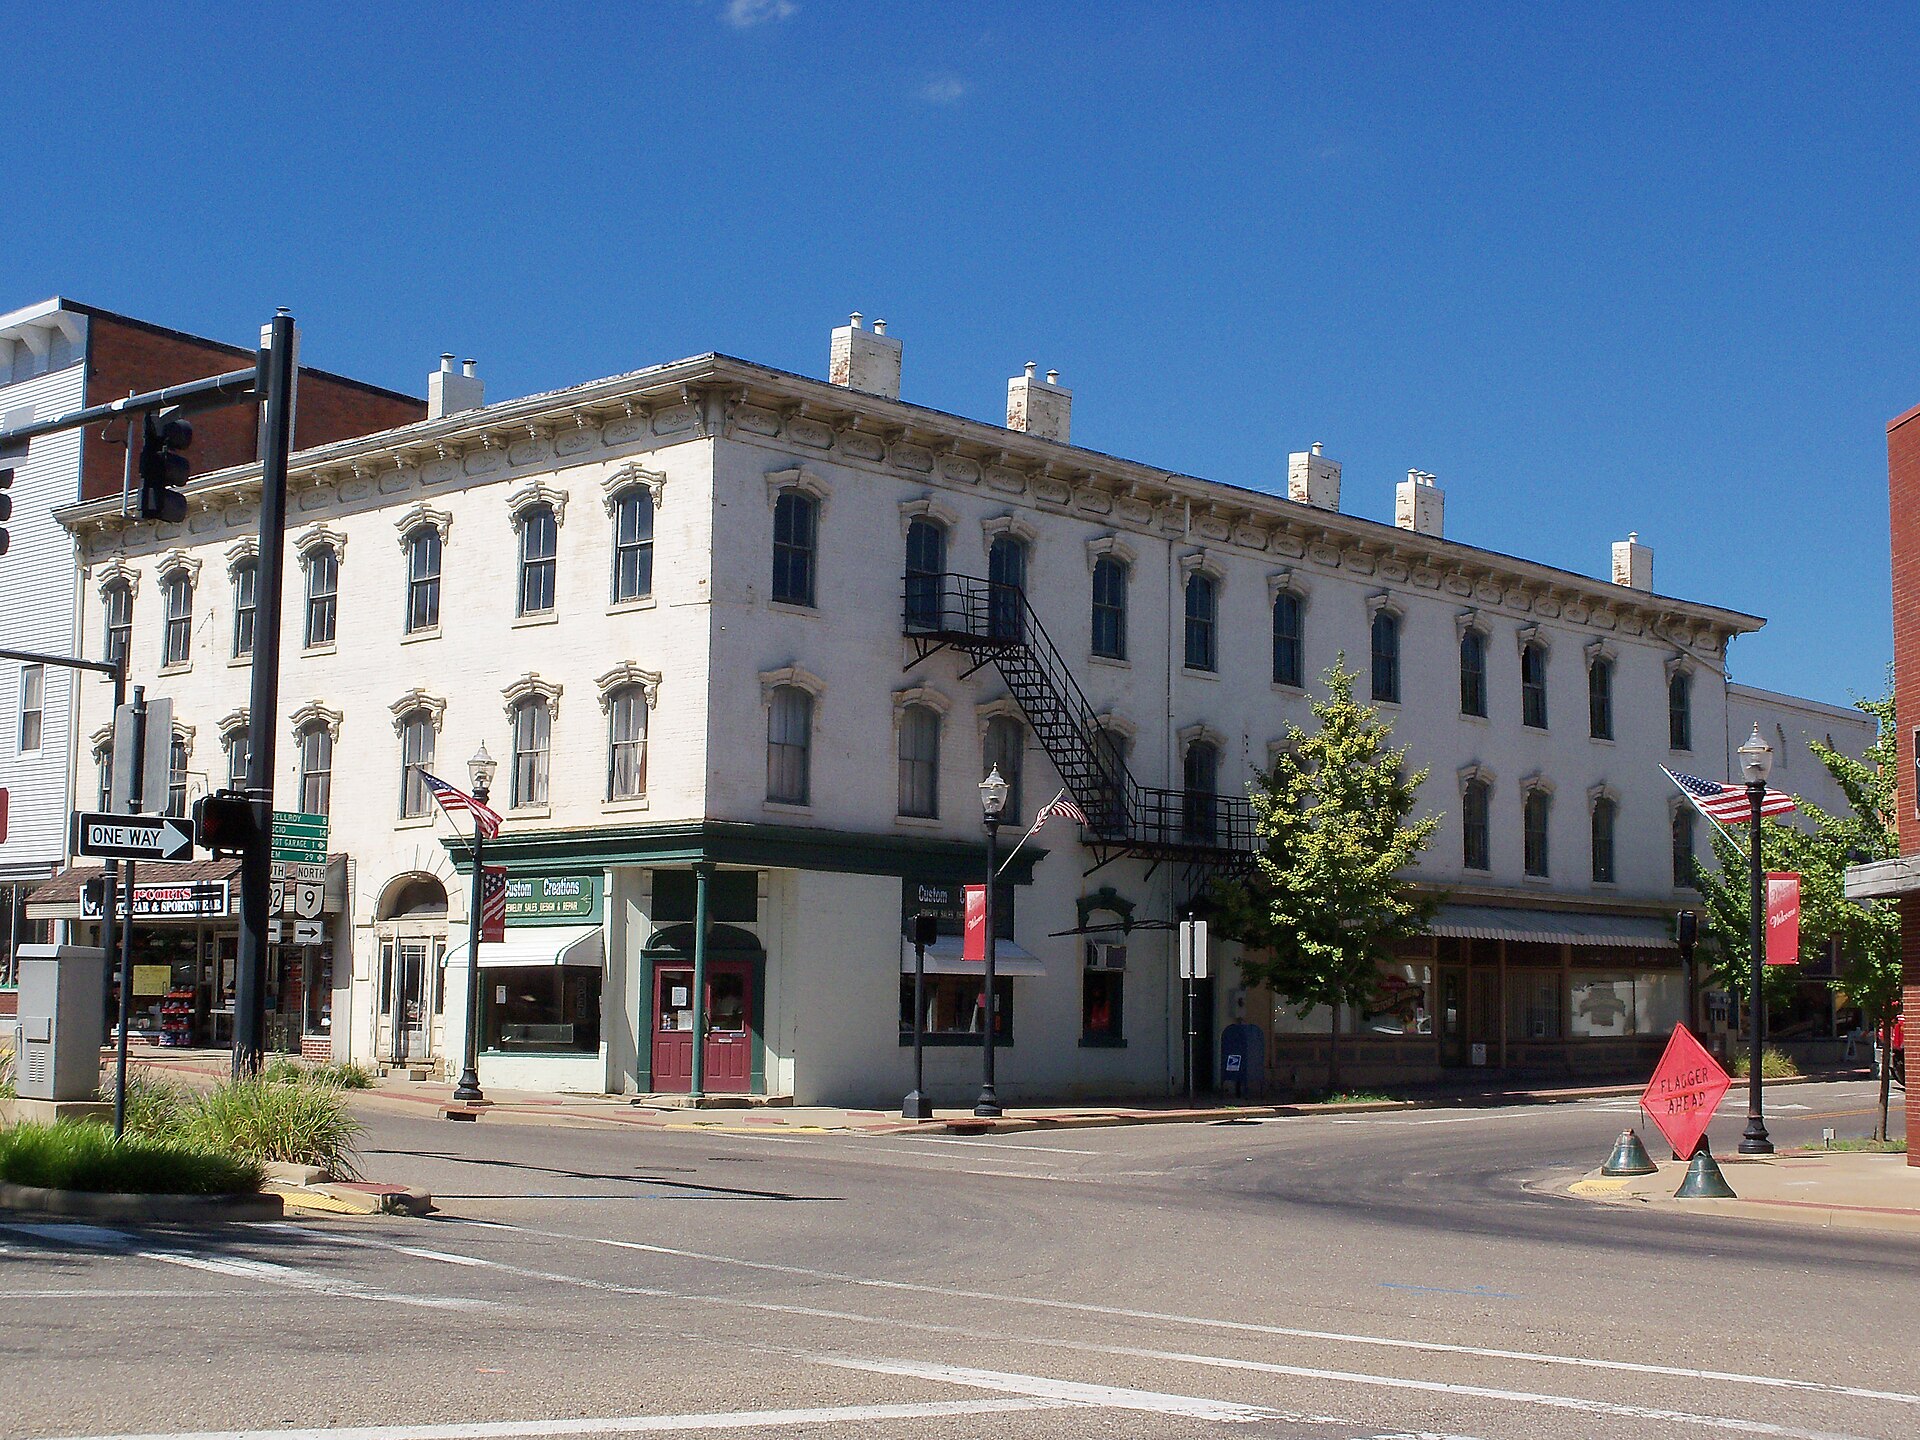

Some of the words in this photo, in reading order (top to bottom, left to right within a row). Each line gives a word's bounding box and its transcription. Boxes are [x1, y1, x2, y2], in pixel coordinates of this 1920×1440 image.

[93, 827, 124, 845] ONE
[130, 829, 161, 846] WAY
[319, 829, 327, 837] 14
[284, 839, 307, 848] GARAGE
[304, 853, 314, 861] 29
[298, 867, 325, 879] NORTH
[505, 880, 532, 898] Custom
[543, 878, 580, 896] Creations
[918, 884, 948, 904] Custom
[151, 902, 160, 912] &
[161, 899, 222, 913] SPORTSWEAR
[304, 890, 315, 909] 9
[1769, 908, 1796, 929] Welcome
[1660, 1067, 1709, 1093] FLAGGER
[1667, 1091, 1706, 1115] AHEAD
